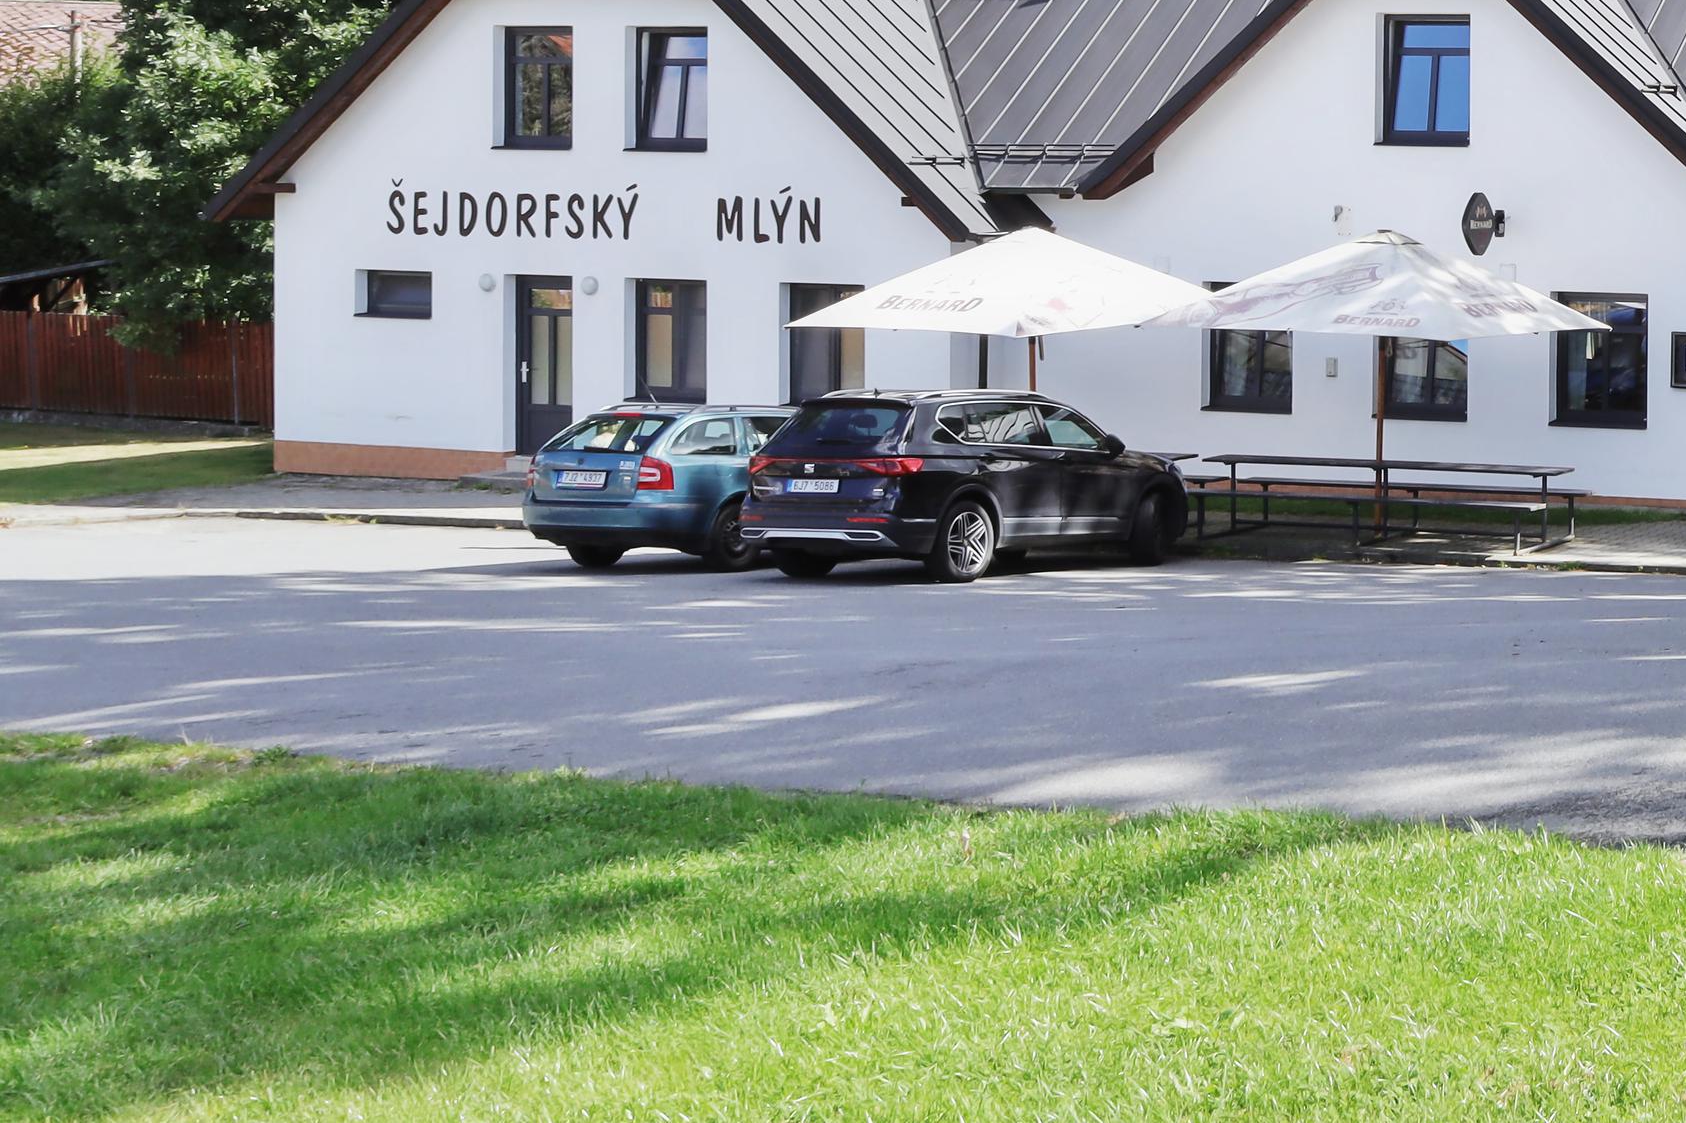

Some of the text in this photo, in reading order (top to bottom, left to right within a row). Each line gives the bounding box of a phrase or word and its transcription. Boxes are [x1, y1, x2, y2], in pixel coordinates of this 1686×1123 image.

[386, 178, 821, 244] ŠEJDORFSKÝ MLÝN
[876, 295, 984, 312] BERNARD
[1332, 314, 1421, 328] BERNARD
